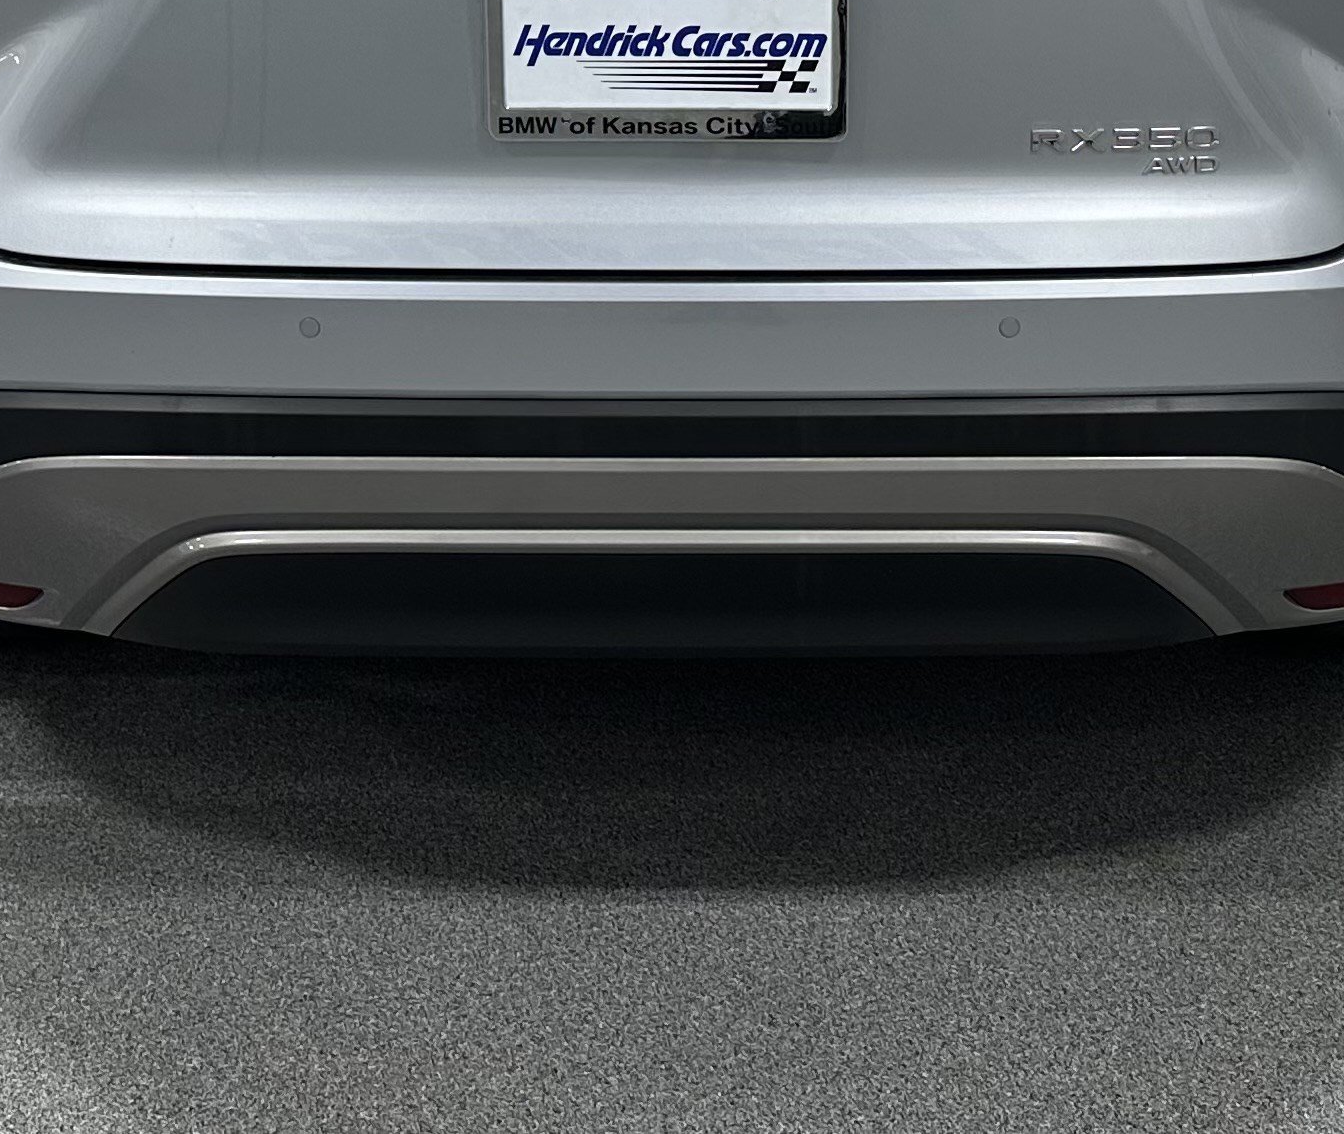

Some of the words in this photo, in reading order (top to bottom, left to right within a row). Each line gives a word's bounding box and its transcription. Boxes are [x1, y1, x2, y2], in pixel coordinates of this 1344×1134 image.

[498, 117, 557, 134] BMW
[569, 117, 595, 134] of
[603, 117, 698, 134] Kansas
[1142, 156, 1219, 174] AWD
